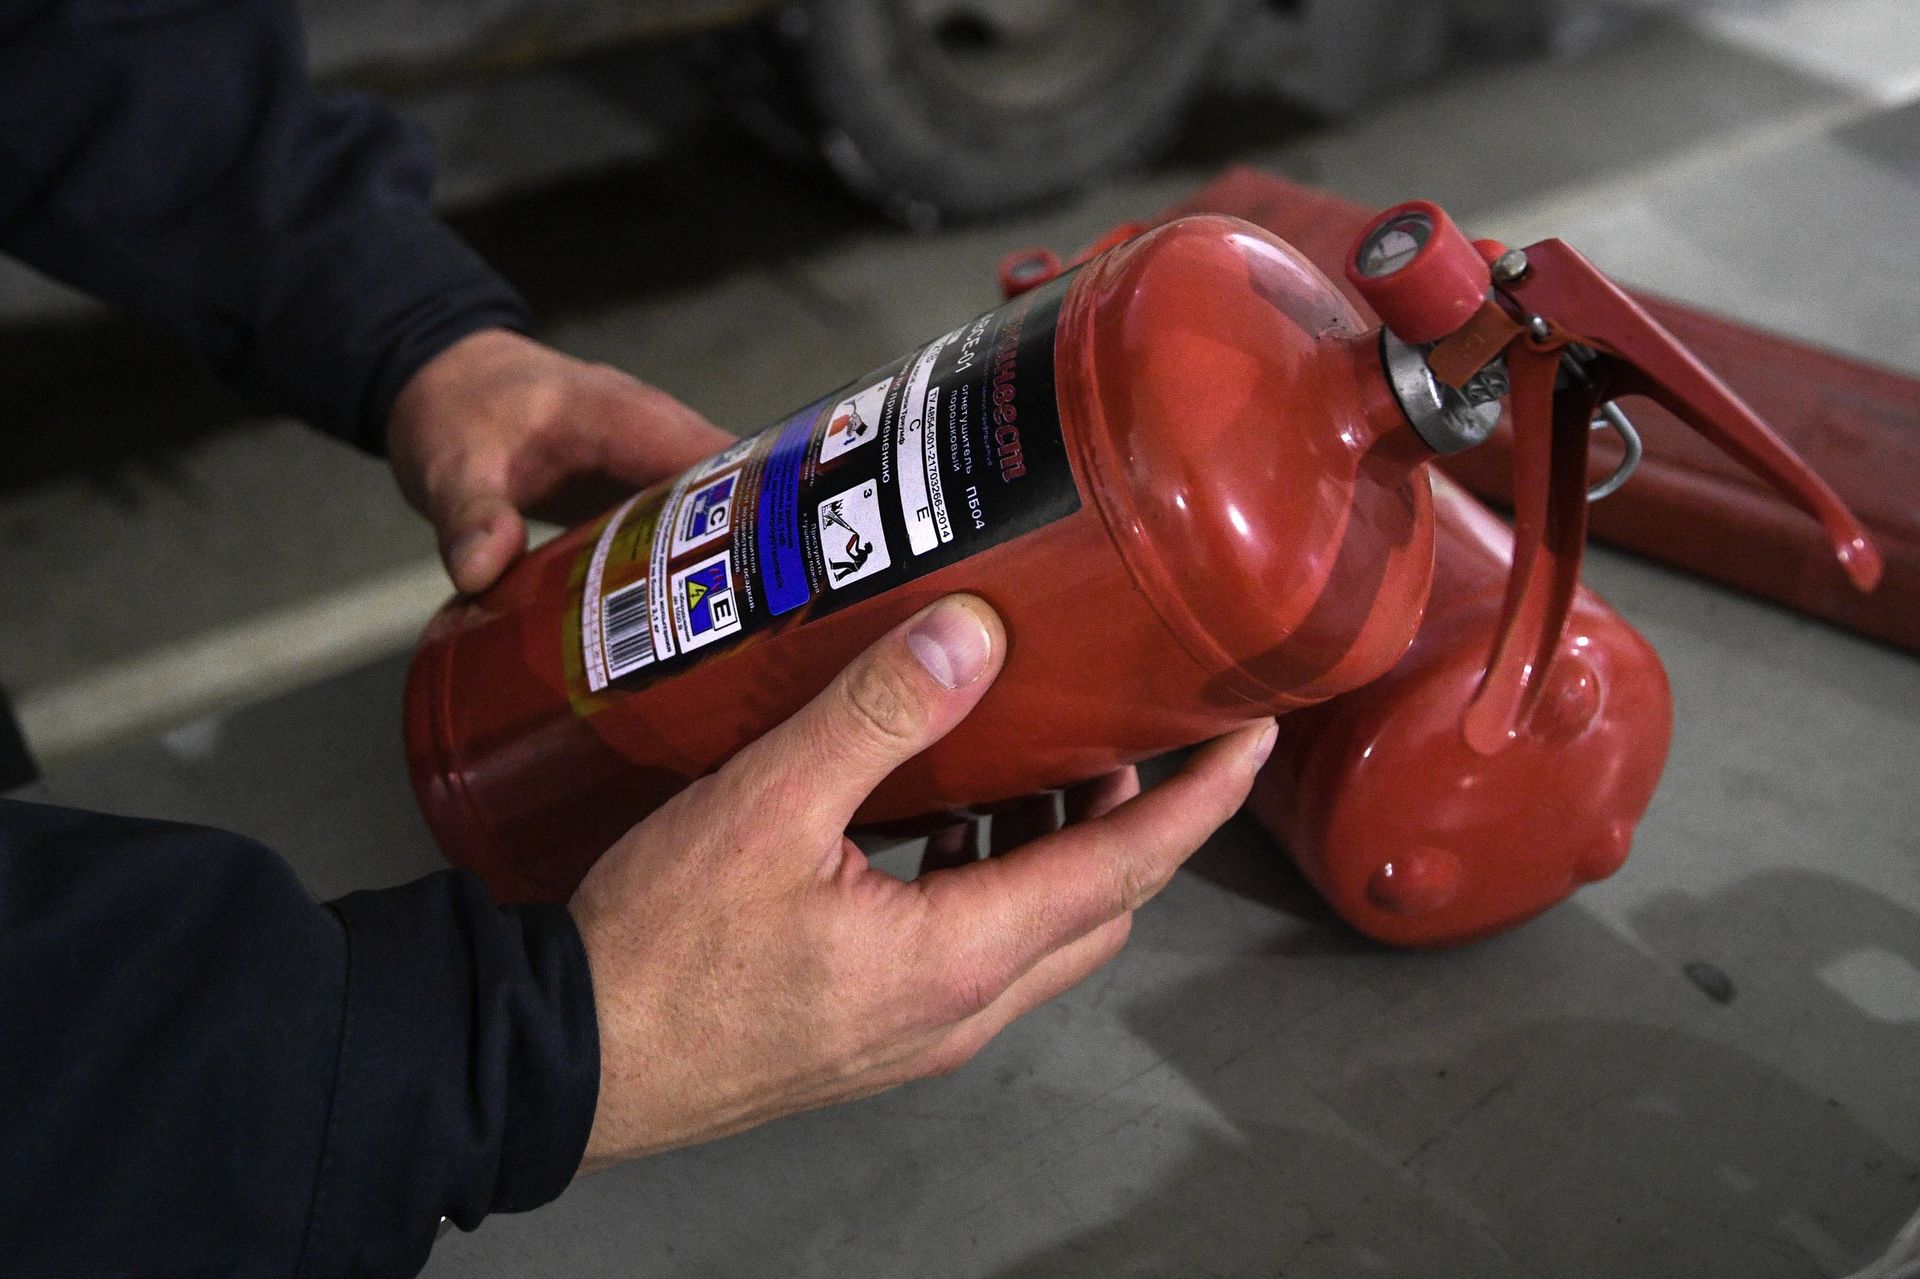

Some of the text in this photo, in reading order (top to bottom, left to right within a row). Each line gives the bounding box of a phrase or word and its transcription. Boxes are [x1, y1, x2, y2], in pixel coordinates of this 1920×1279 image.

[882, 392, 898, 483] применению
[926, 406, 950, 538] 4854-001-21703266-2014
[948, 390, 961, 472] порошковый
[959, 384, 985, 530] огнетушитель ПБ04
[864, 488, 872, 499] 3
